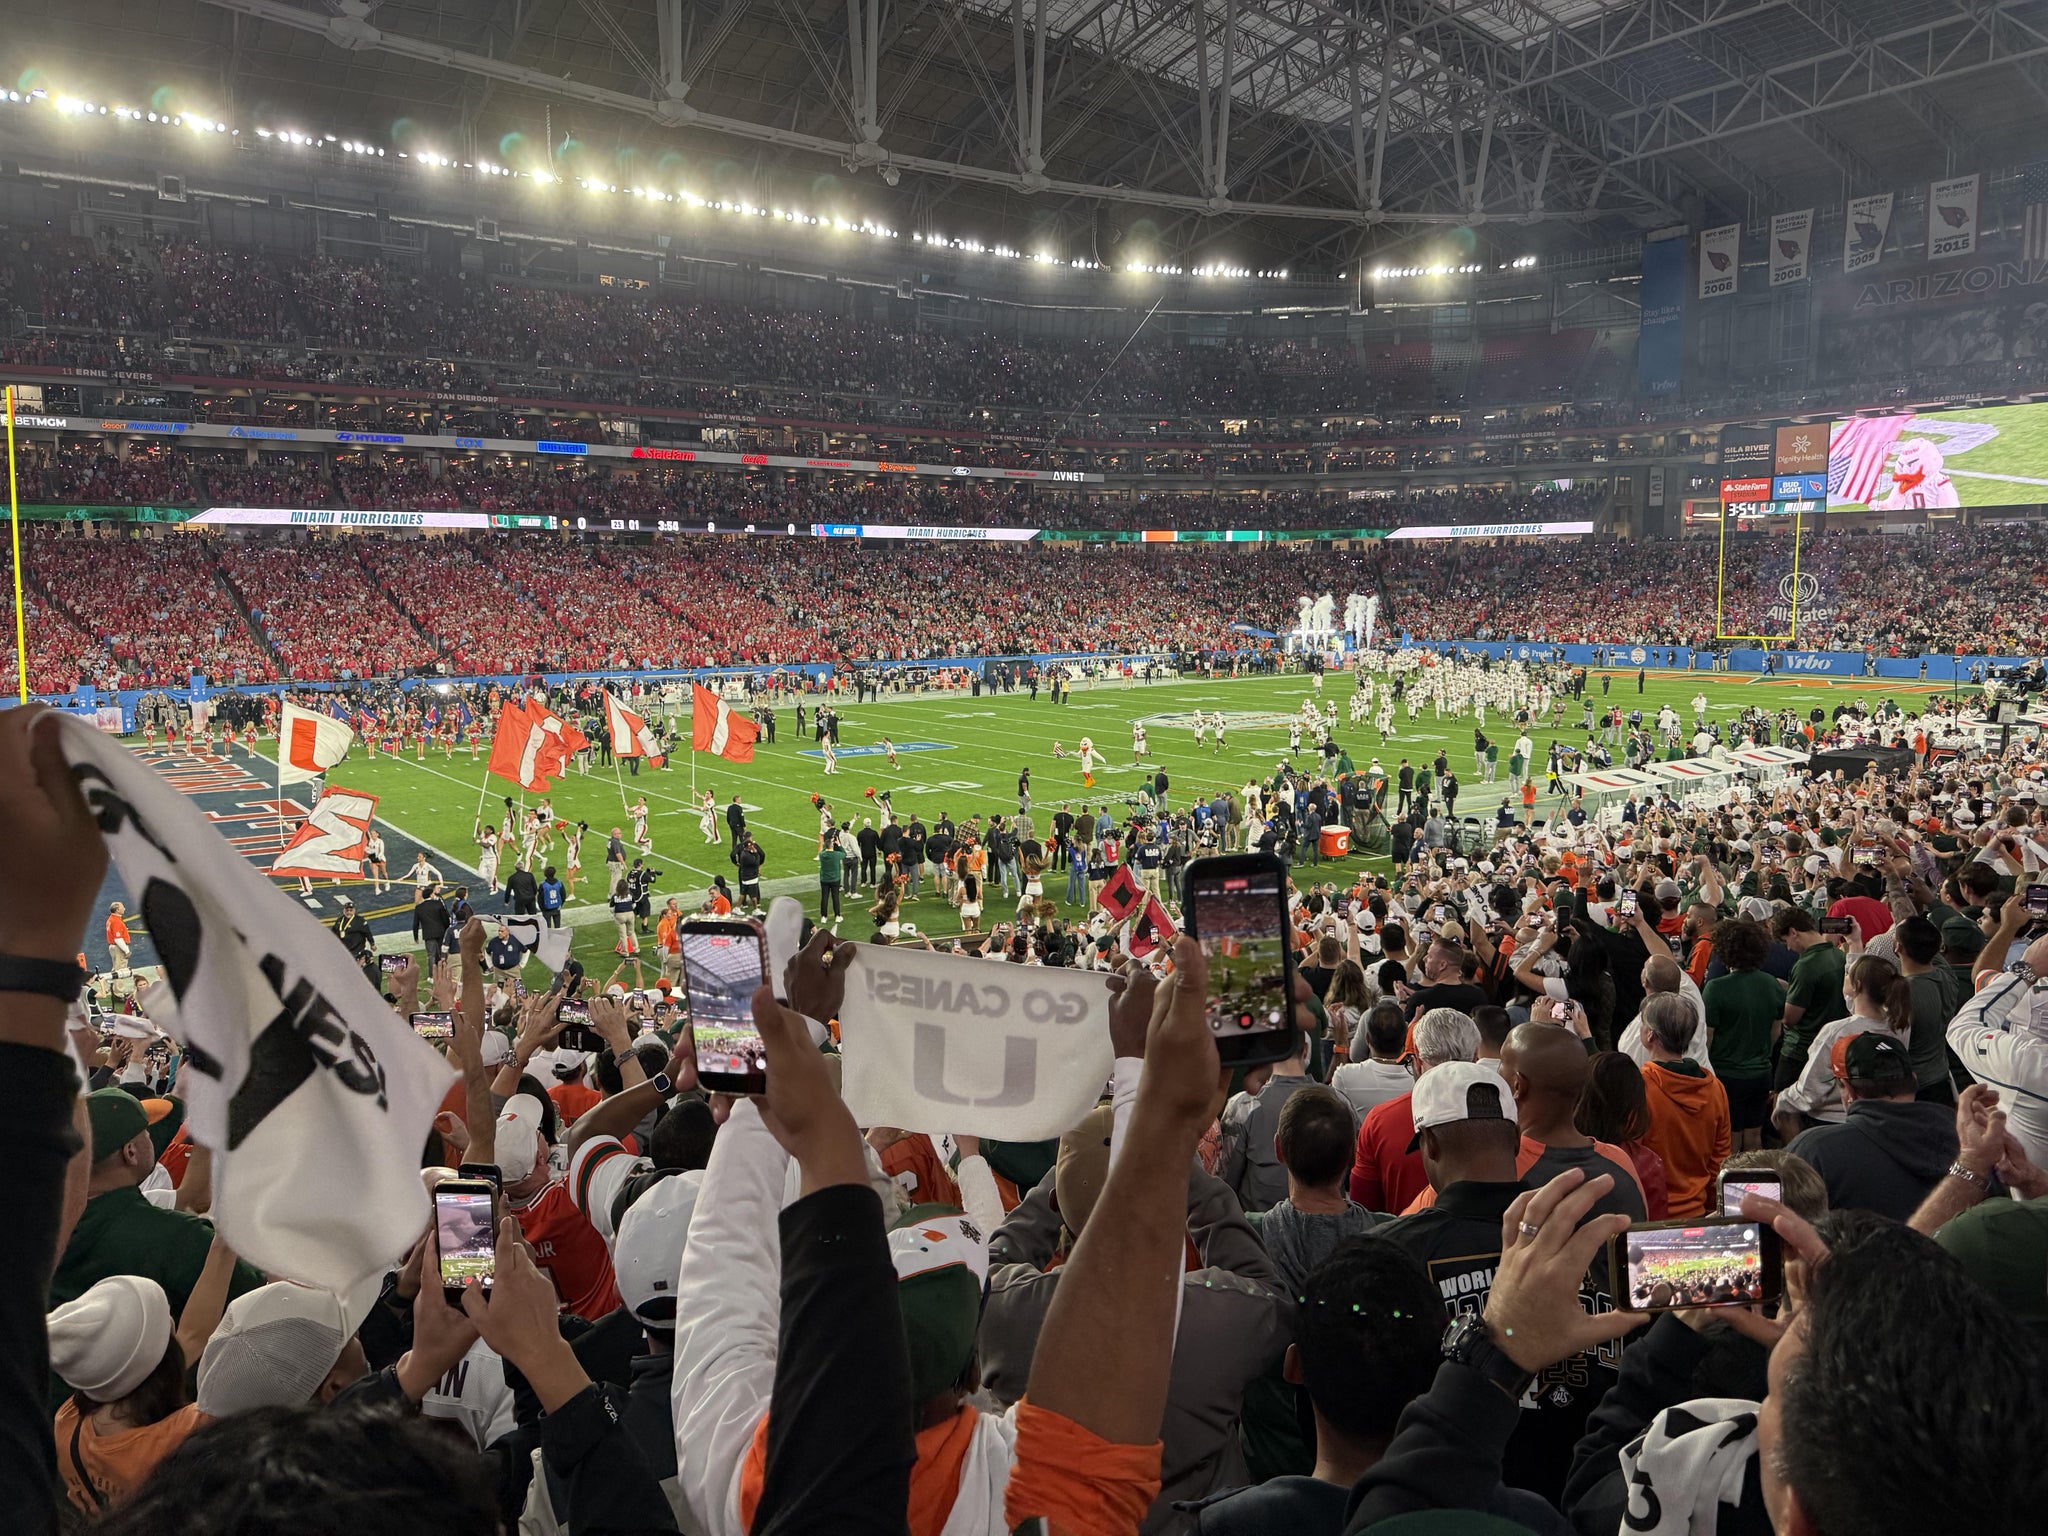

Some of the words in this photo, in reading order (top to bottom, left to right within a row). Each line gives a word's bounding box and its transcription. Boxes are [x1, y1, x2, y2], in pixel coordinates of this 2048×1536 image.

[1953, 181, 1973, 190] WEST
[1718, 227, 1735, 236] WEST
[1933, 238, 1970, 255] 2015
[1848, 252, 1875, 268] 2009
[1773, 268, 1802, 282] 2008
[1703, 282, 1733, 295] 2008
[75, 368, 108, 378] ERNIE
[457, 394, 499, 403] DIERDORF
[1933, 392, 1982, 402] CARDINALS
[14, 416, 67, 428] BETMGM
[704, 412, 728, 420] LARRY
[728, 414, 756, 422] WILSON
[101, 421, 126, 430] desert
[354, 434, 404, 443] HYUNDAI
[455, 438, 483, 449] COX
[1724, 446, 1744, 454] GILA
[1744, 444, 1770, 452] RIVER
[1777, 455, 1800, 464] Dignity
[1802, 453, 1824, 461] Health
[1053, 470, 1085, 482] AVNET
[1779, 486, 1803, 494] LIGHT
[1728, 502, 1756, 517] 3:54
[1783, 501, 1816, 512] MIAMI
[290, 511, 335, 523] MIAMI
[340, 512, 424, 525] HURRICANES
[657, 520, 680, 532] 3:54
[1450, 526, 1481, 536] MIAMI
[1483, 524, 1543, 535] HURRICANES
[906, 527, 934, 538] MIAMI
[936, 528, 987, 538] HURRICANES
[1765, 605, 1828, 622] Allstate
[1786, 654, 1832, 671] Vrbo
[1336, 836, 1347, 850] G
[259, 951, 389, 1113] NES!
[1438, 1265, 1501, 1299] WORL
